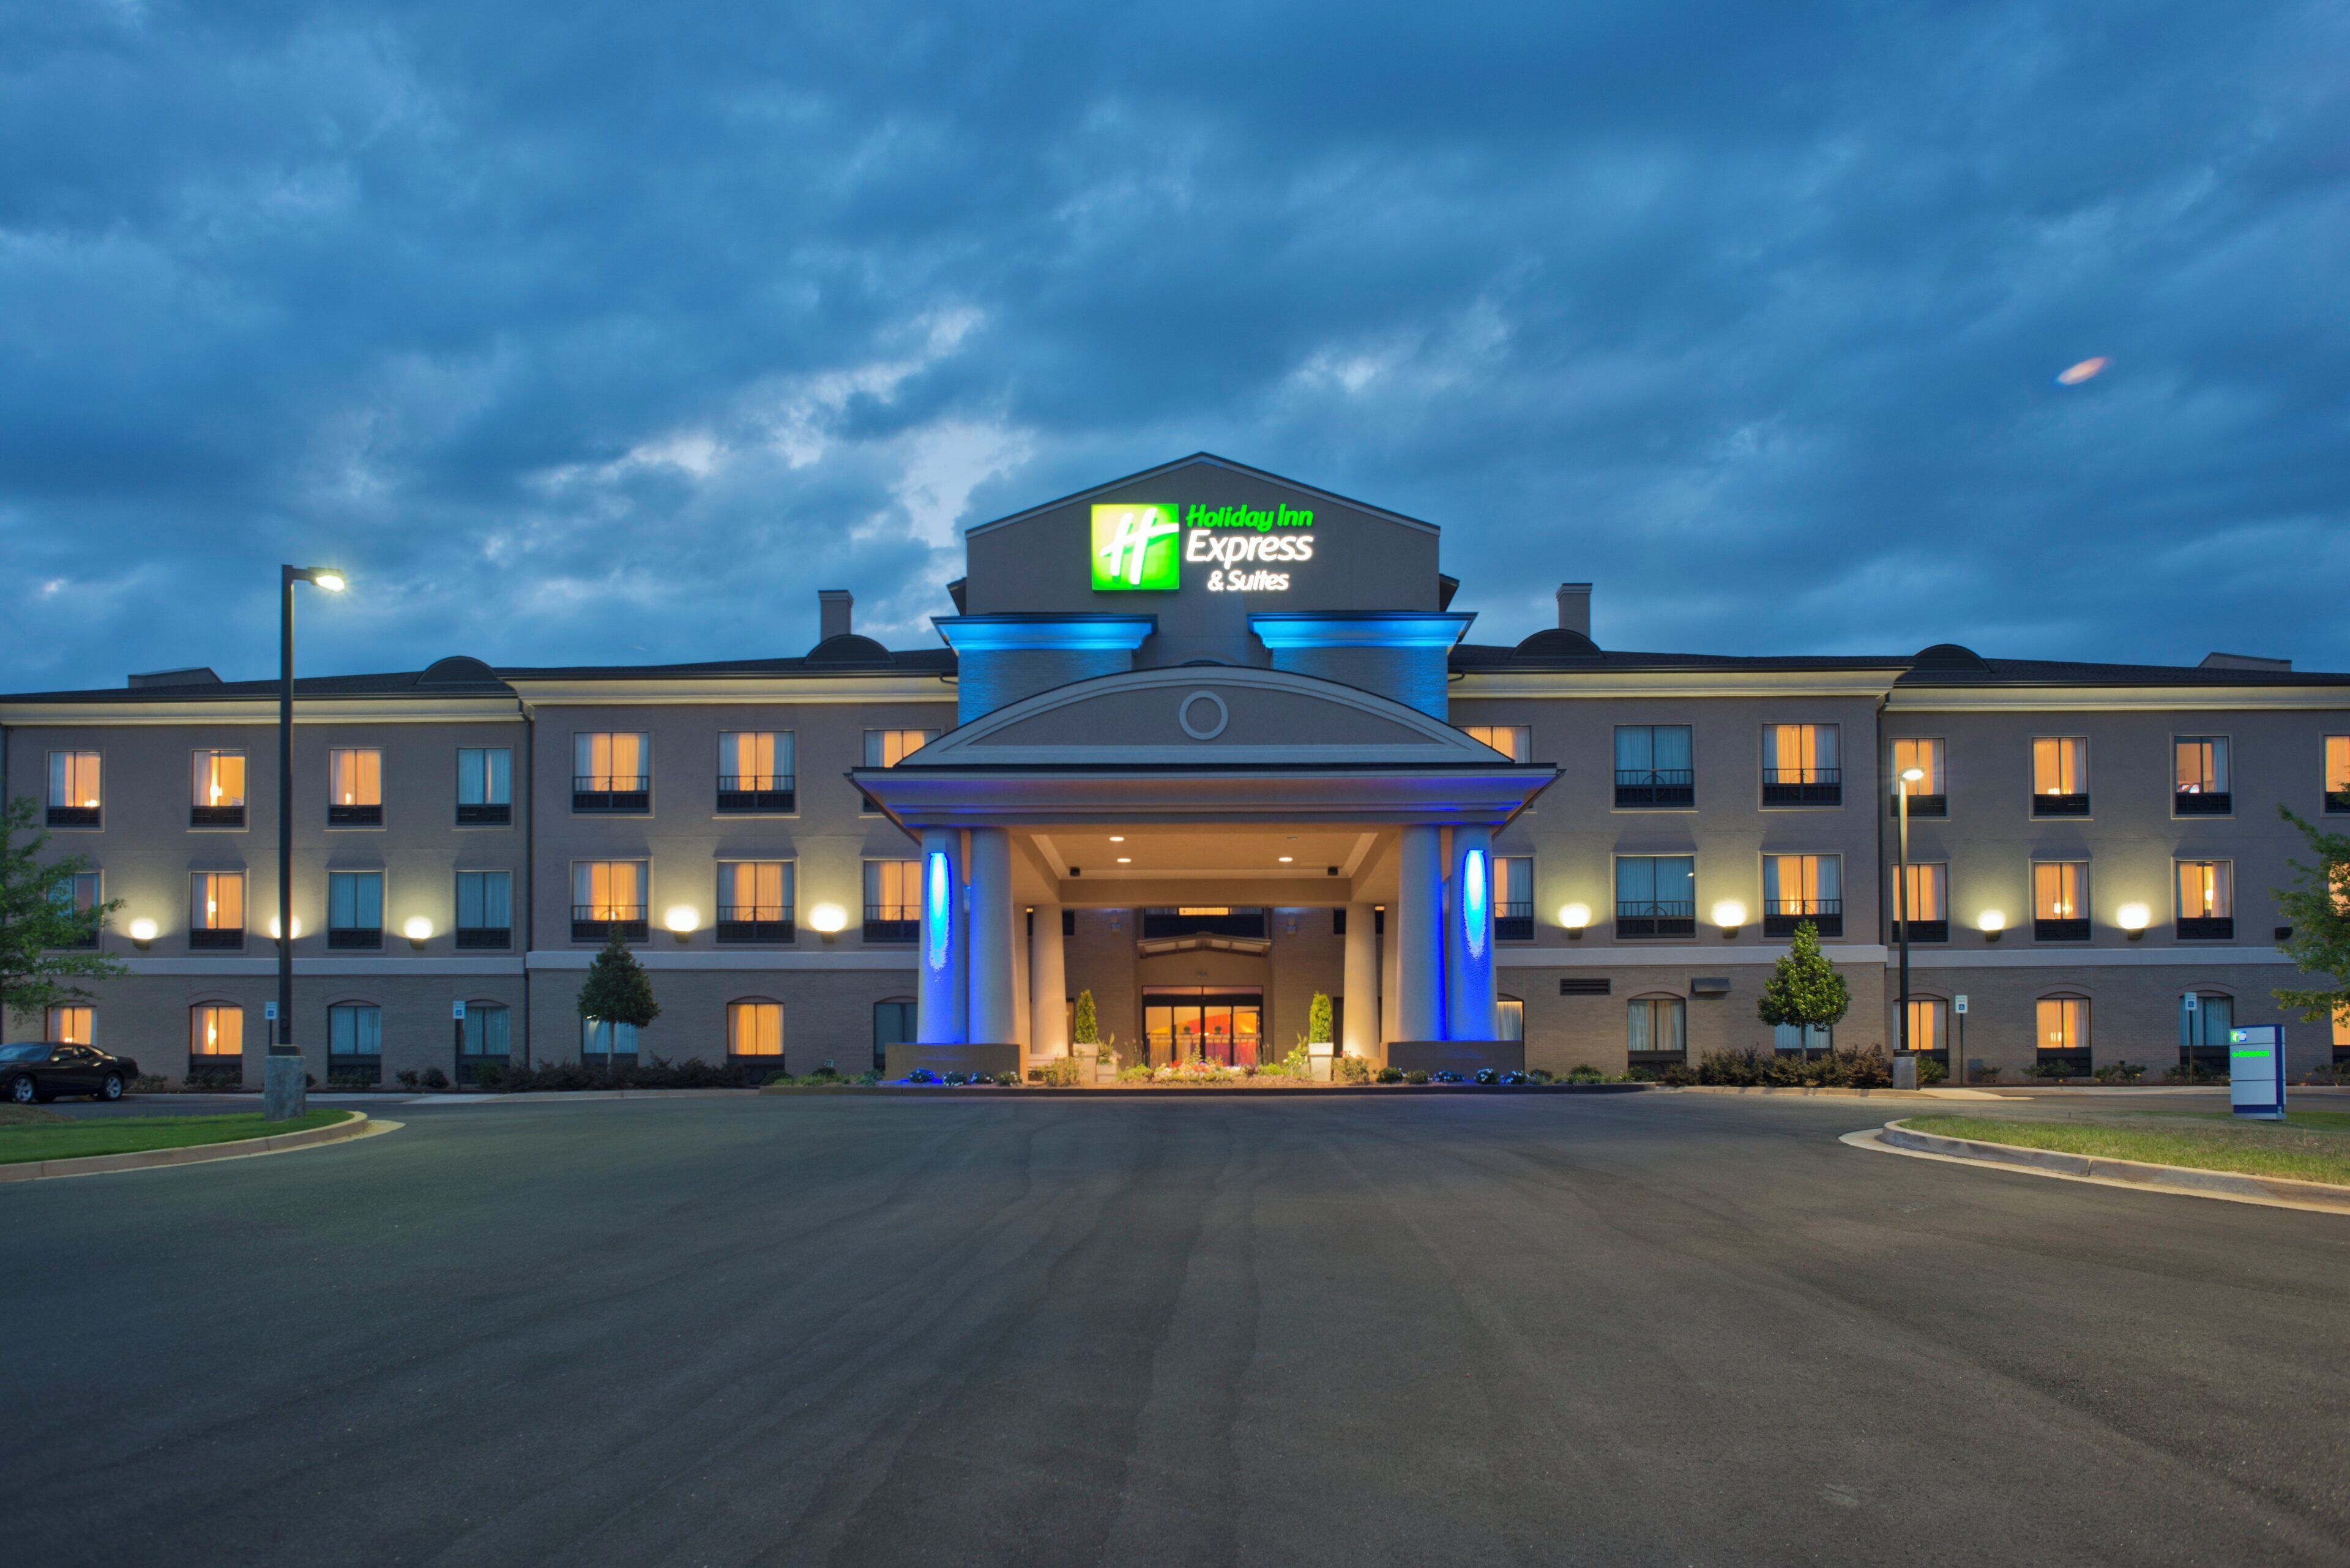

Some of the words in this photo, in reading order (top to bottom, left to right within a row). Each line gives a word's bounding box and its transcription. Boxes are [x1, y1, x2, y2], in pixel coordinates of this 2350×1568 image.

[1185, 504, 1275, 532] Holiday
[1277, 503, 1313, 526] Inn
[1186, 529, 1314, 569] Express
[1207, 570, 1224, 591] &
[1226, 570, 1289, 591] Suites
